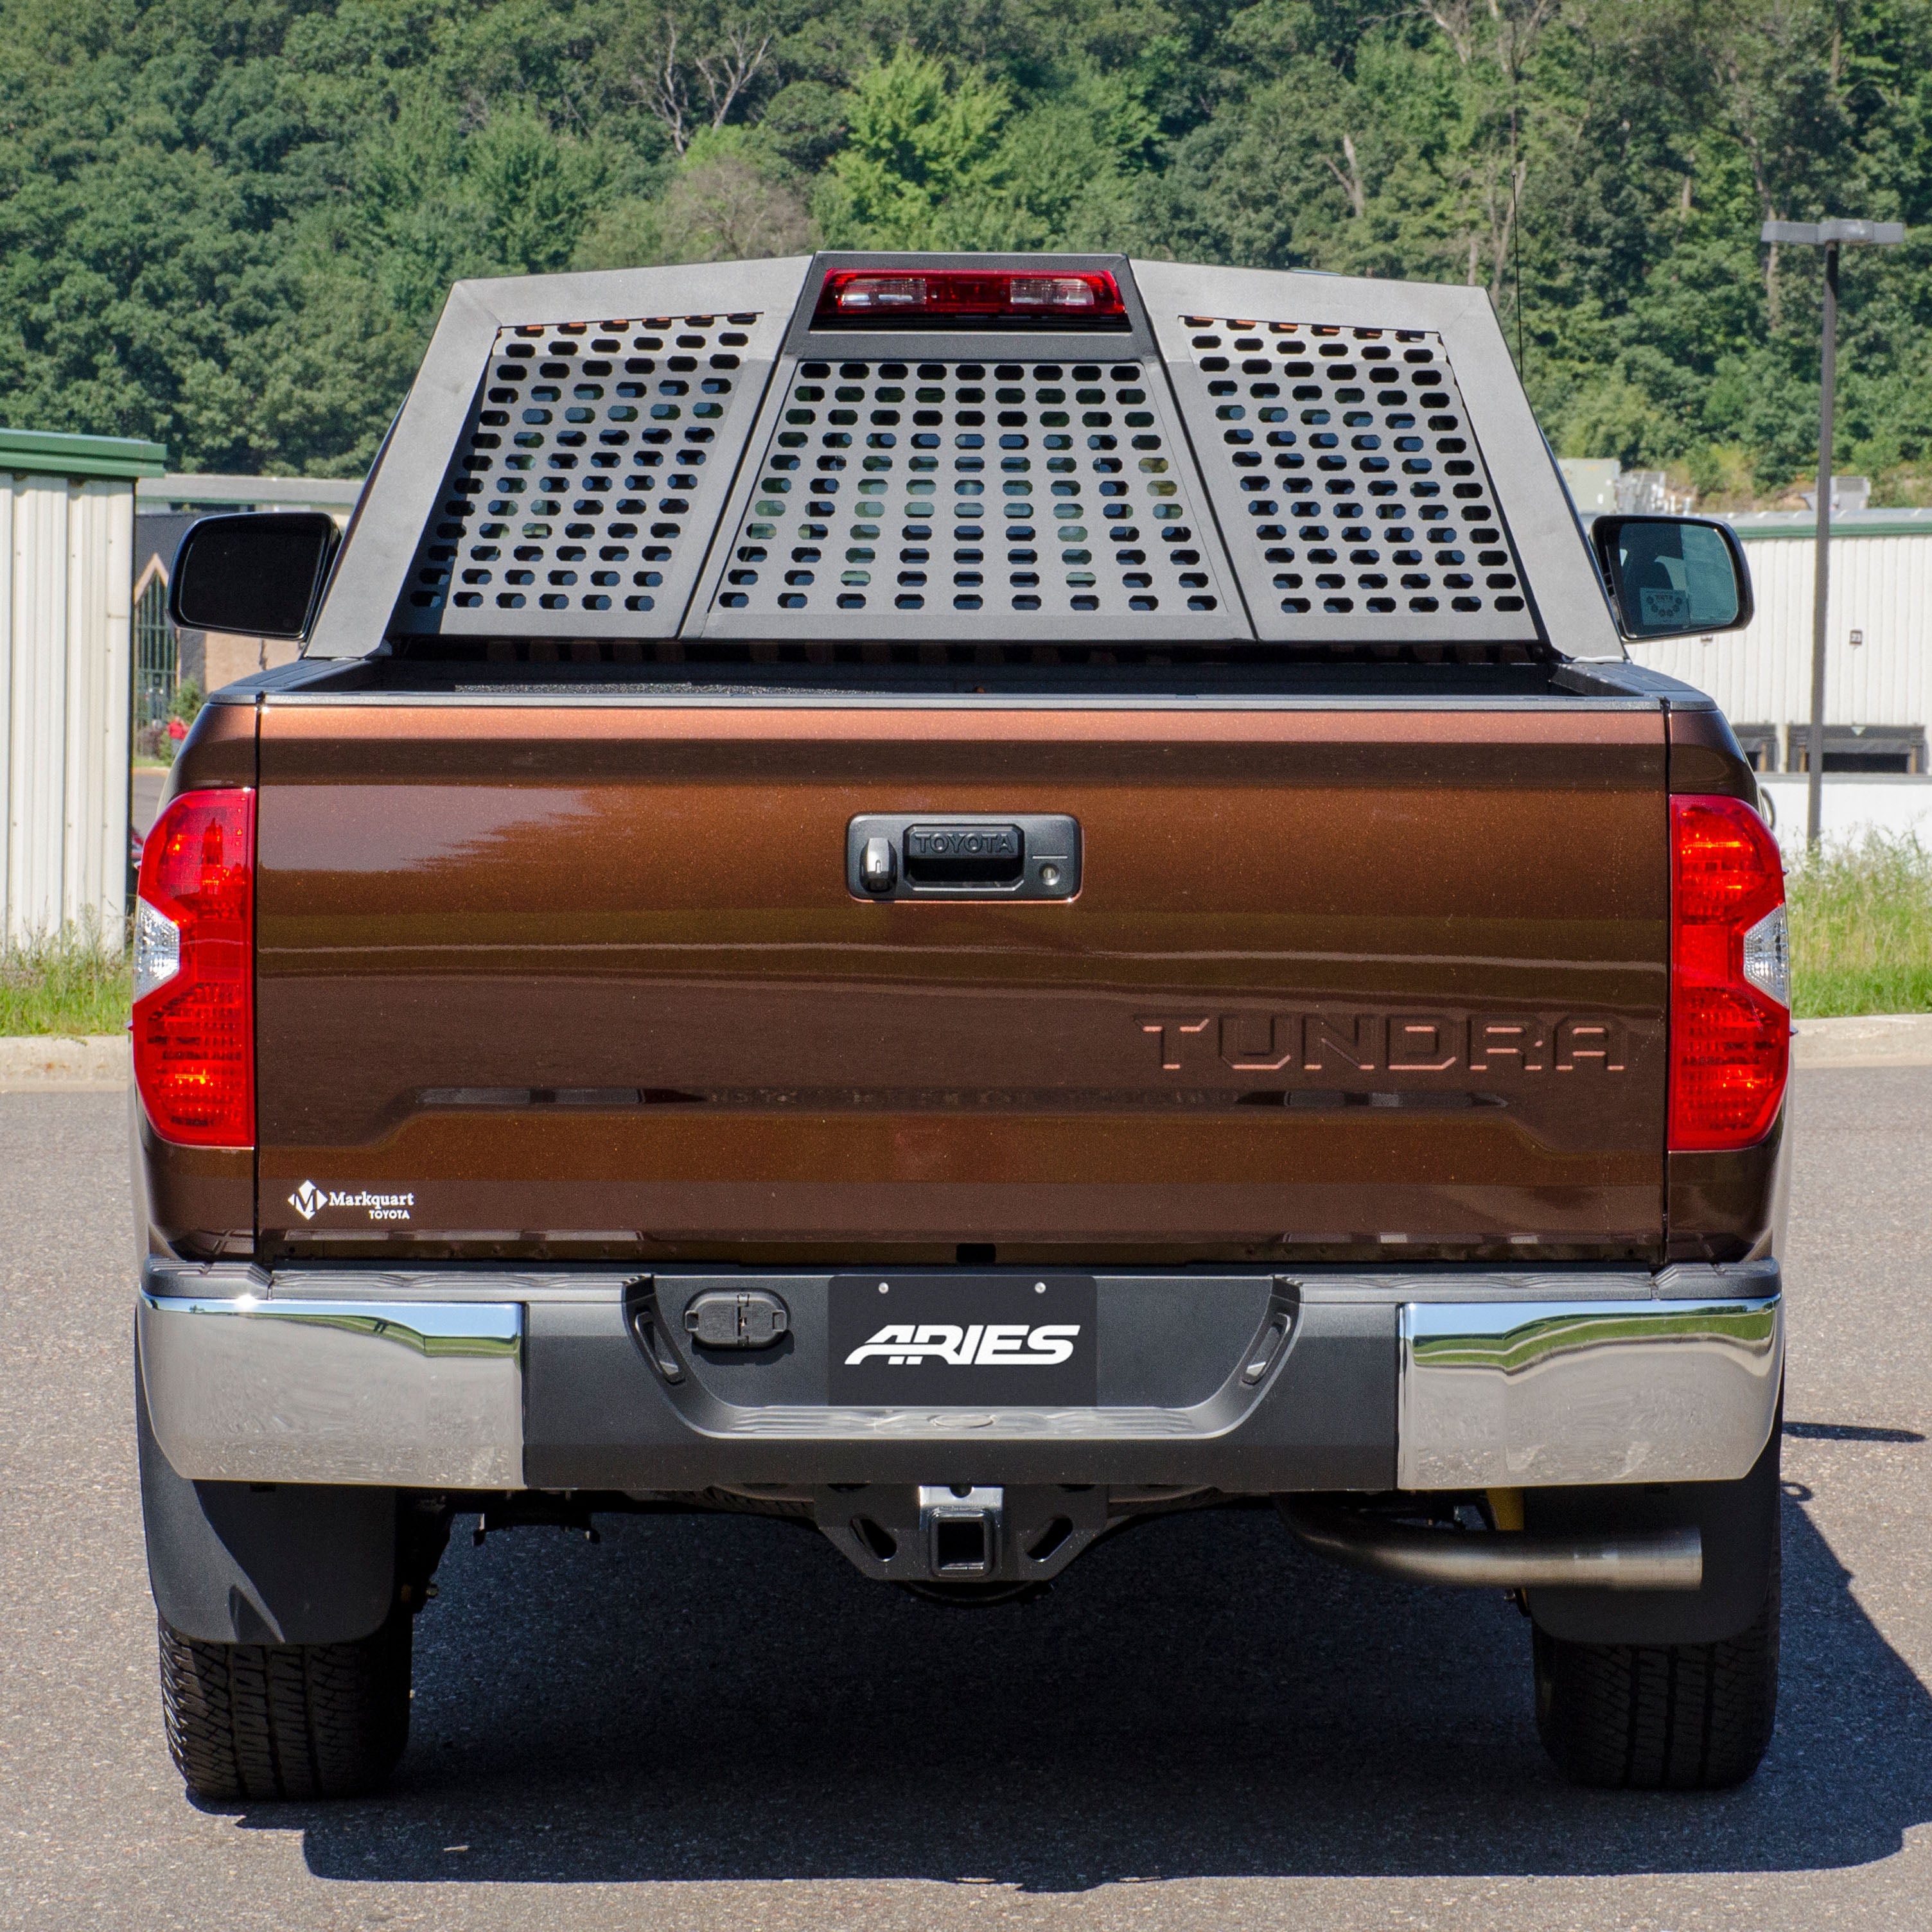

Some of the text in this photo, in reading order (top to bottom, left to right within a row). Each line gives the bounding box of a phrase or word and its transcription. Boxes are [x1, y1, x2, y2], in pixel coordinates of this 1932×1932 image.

[915, 834, 1015, 854] TOYOTA
[1134, 1013, 1625, 1071] TUNDRA
[329, 1191, 414, 1209] Markquart
[369, 1209, 410, 1220] TOYOTA
[844, 1325, 1080, 1365] ARIES
